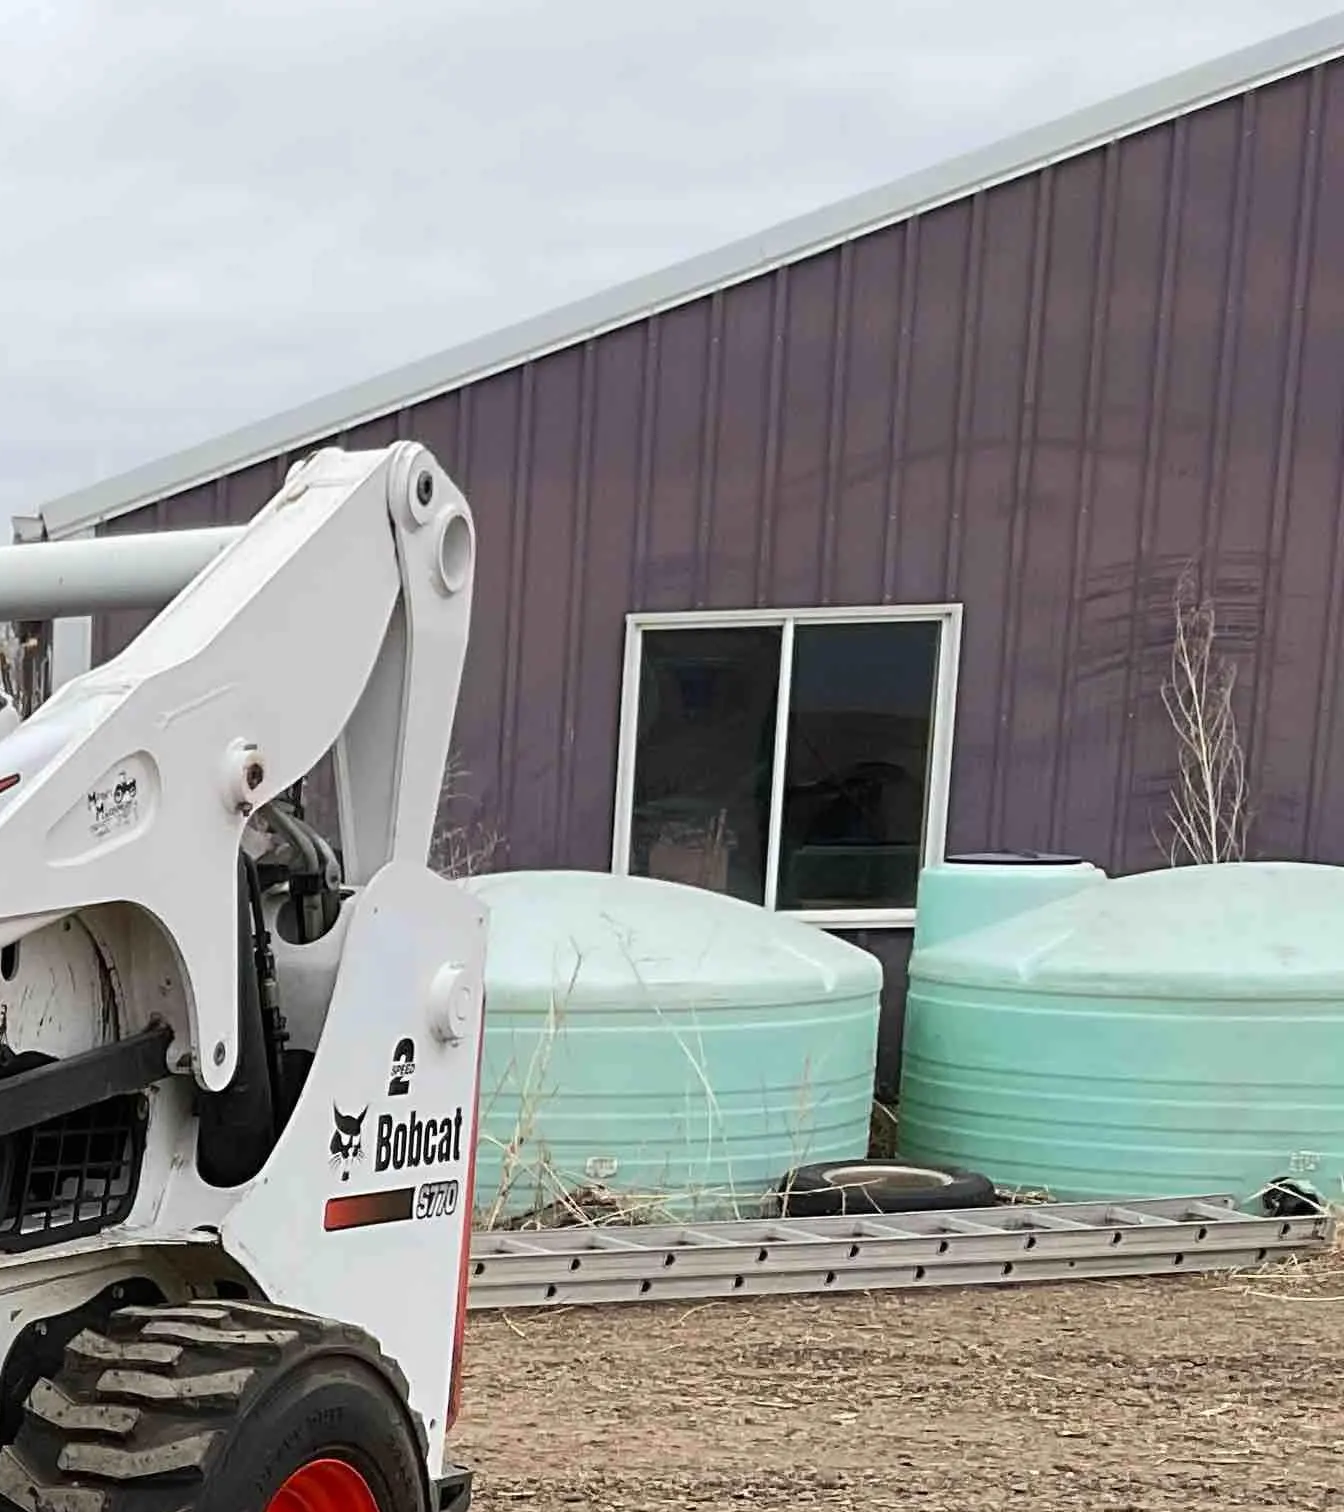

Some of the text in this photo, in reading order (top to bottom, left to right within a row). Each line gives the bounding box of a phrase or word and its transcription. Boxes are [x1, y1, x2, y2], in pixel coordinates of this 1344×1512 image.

[388, 1038, 415, 1097] 2
[391, 1063, 416, 1076] SPEED
[375, 1107, 463, 1173] Bobcat
[416, 1180, 459, 1220] S770
